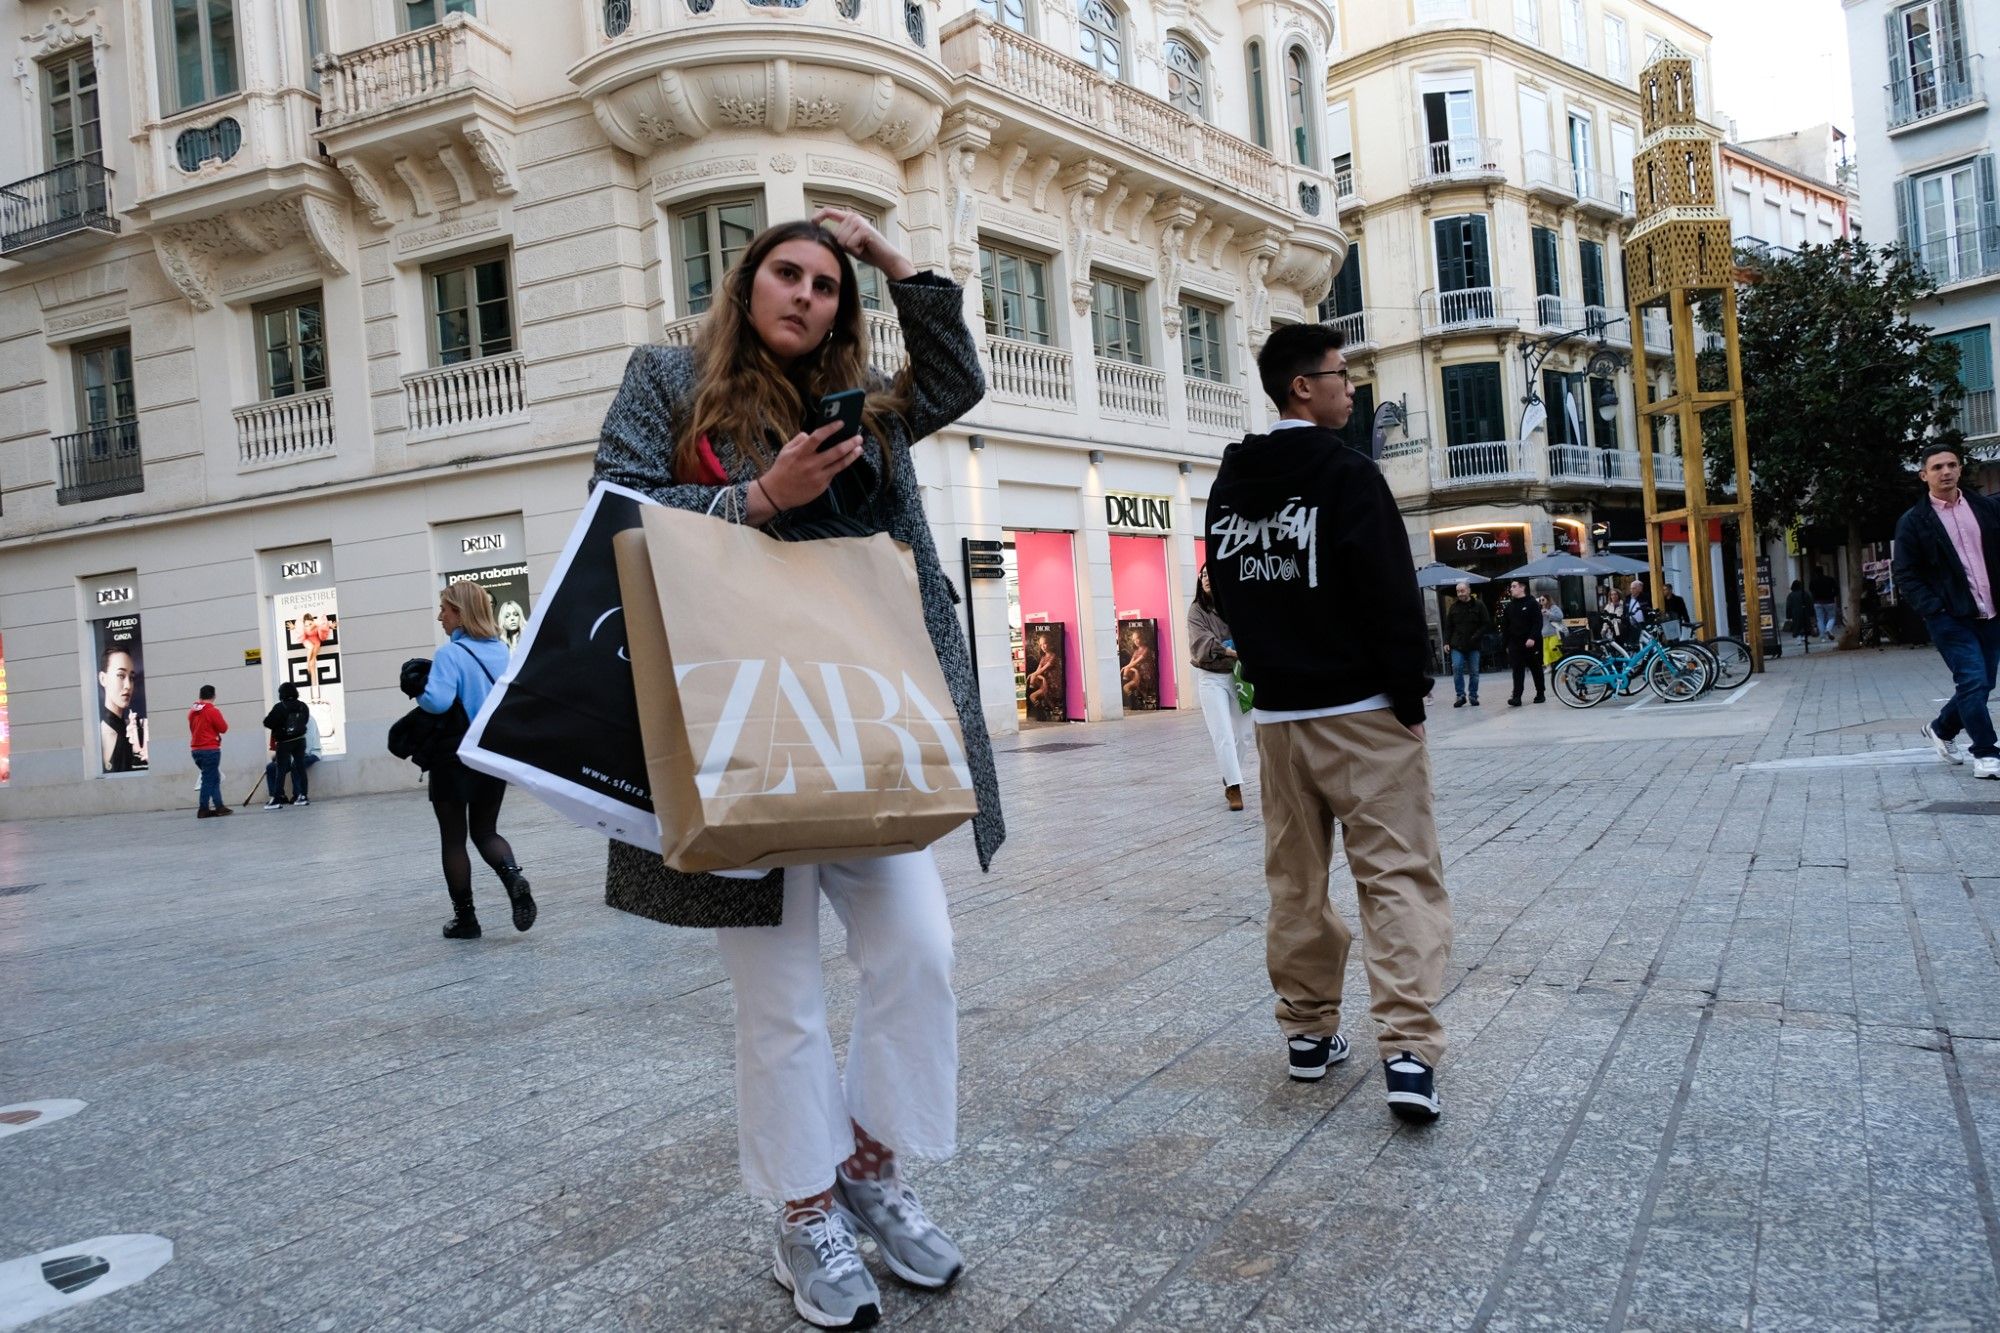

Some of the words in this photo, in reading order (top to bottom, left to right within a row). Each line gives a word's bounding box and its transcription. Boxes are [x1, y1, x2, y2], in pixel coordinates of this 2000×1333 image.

[1105, 495, 1171, 530] DRUNI
[461, 534, 502, 553] DRUNI
[281, 560, 318, 578] DRUNI
[449, 572, 479, 586] paco
[480, 565, 529, 580] rabanne
[1239, 552, 1301, 581] LONDON
[96, 588, 129, 603] DRUNI
[281, 590, 336, 606] IRRESISTIBLE
[105, 618, 138, 629] SHISEIDO
[674, 656, 974, 799] ZARA
